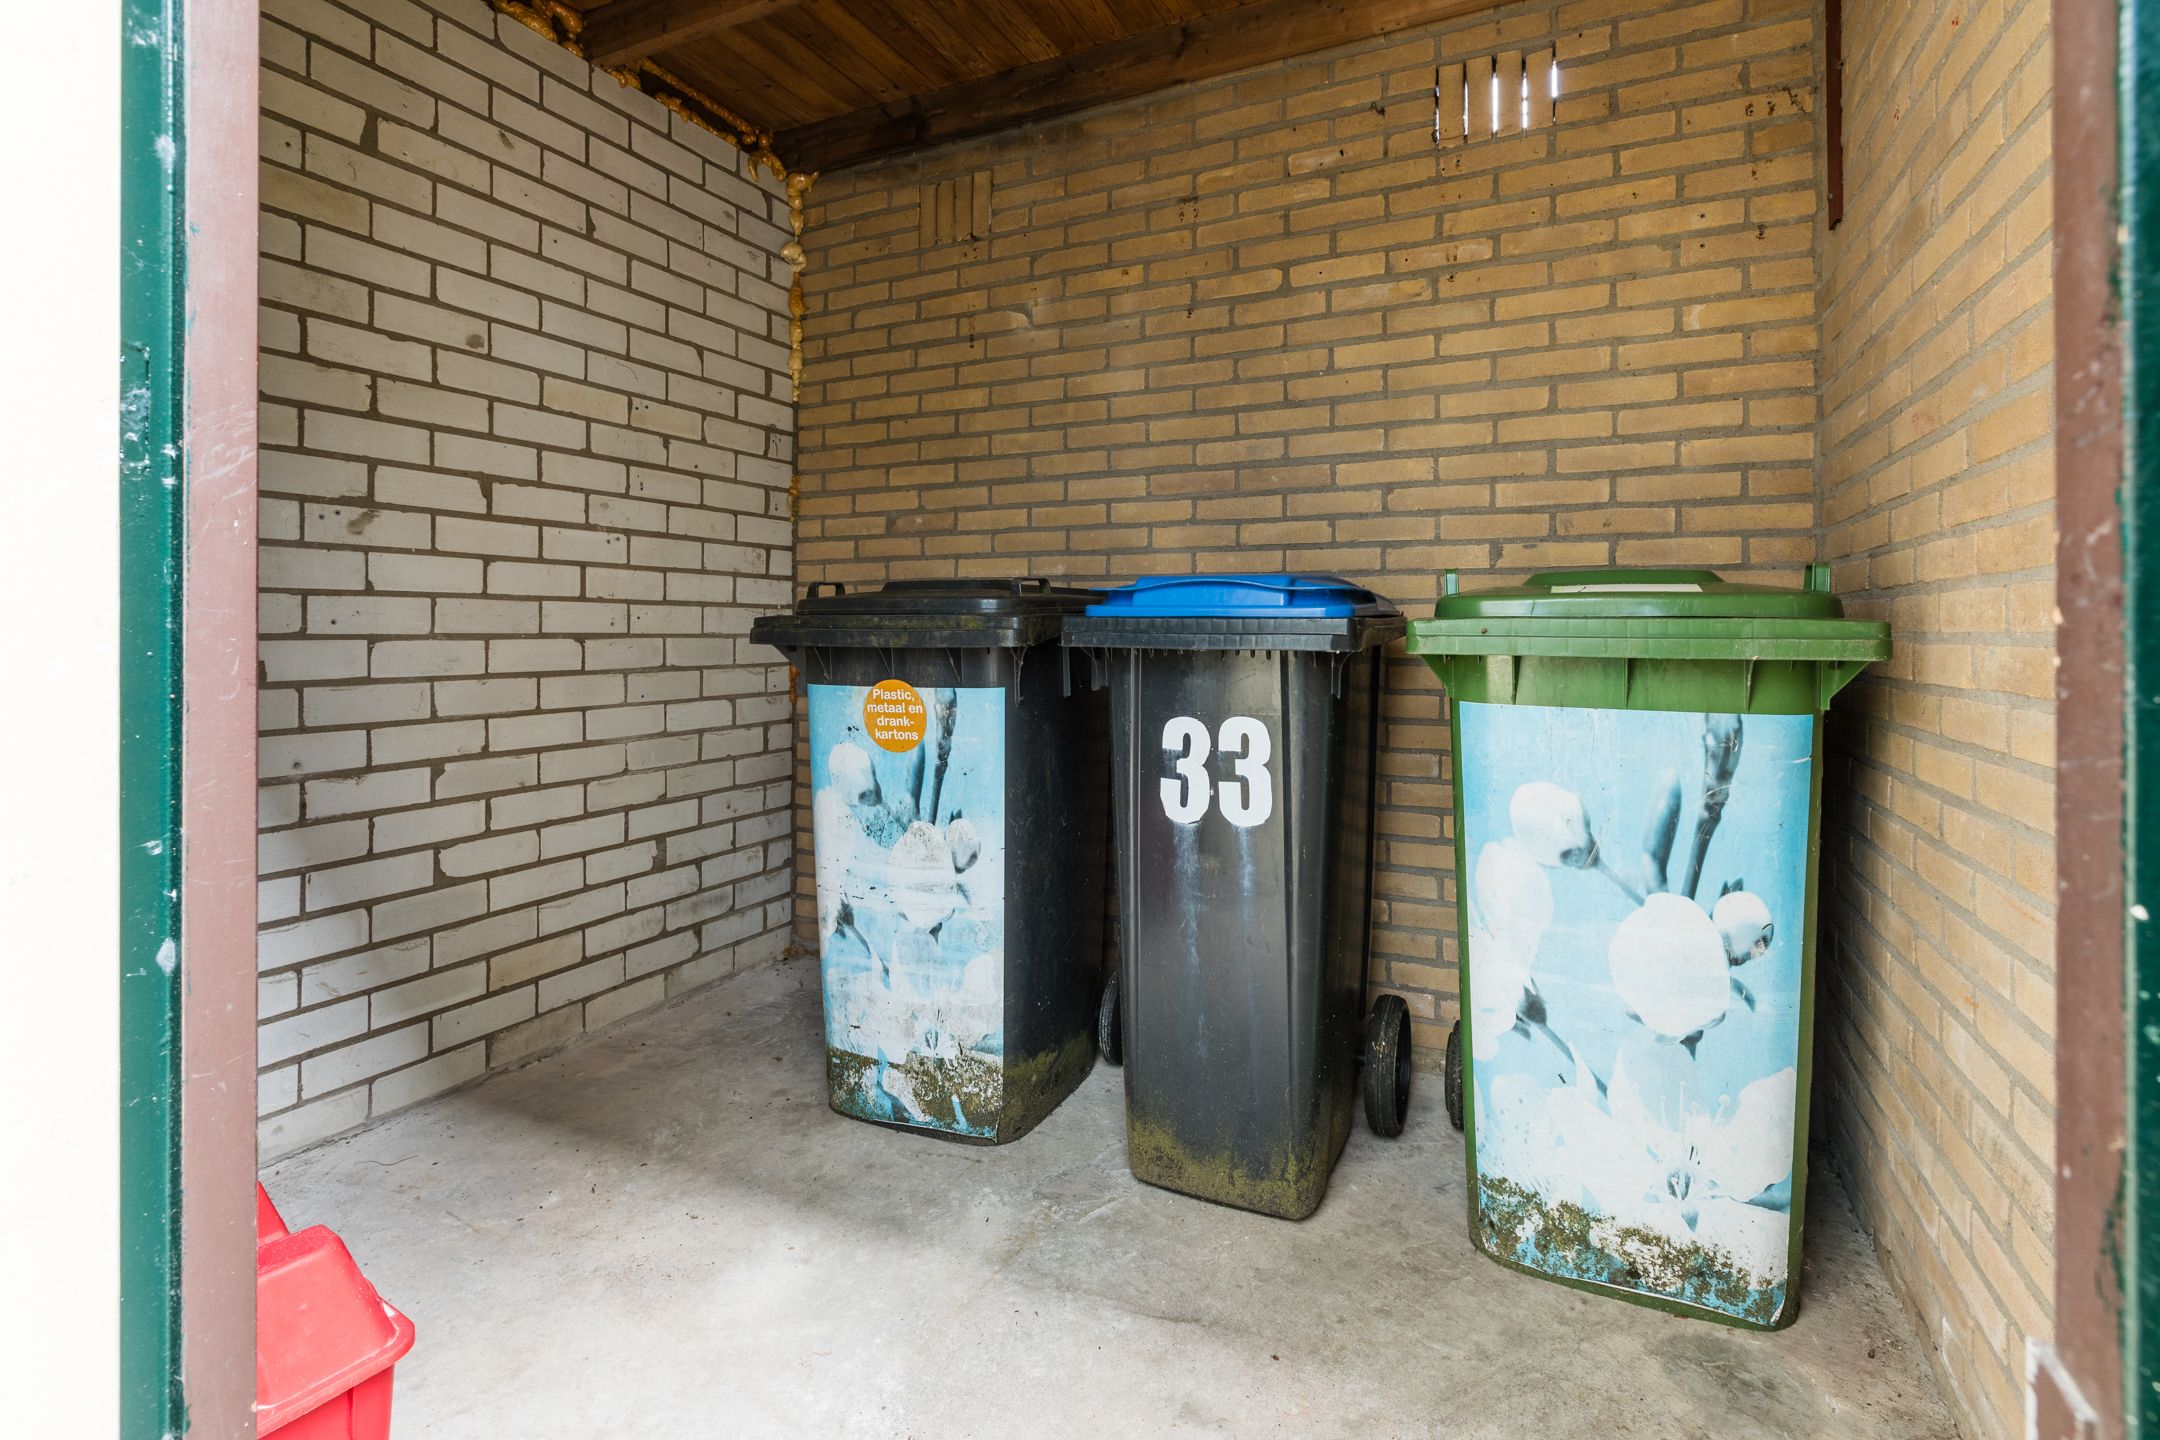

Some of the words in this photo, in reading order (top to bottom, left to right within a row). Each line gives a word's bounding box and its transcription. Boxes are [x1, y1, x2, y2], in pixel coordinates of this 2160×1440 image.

[873, 689, 915, 702] Plastic,
[867, 703, 905, 713] metaal
[908, 705, 923, 714] en
[877, 715, 915, 727] drank-
[875, 728, 919, 740] kartons
[1160, 716, 1273, 827] 33
